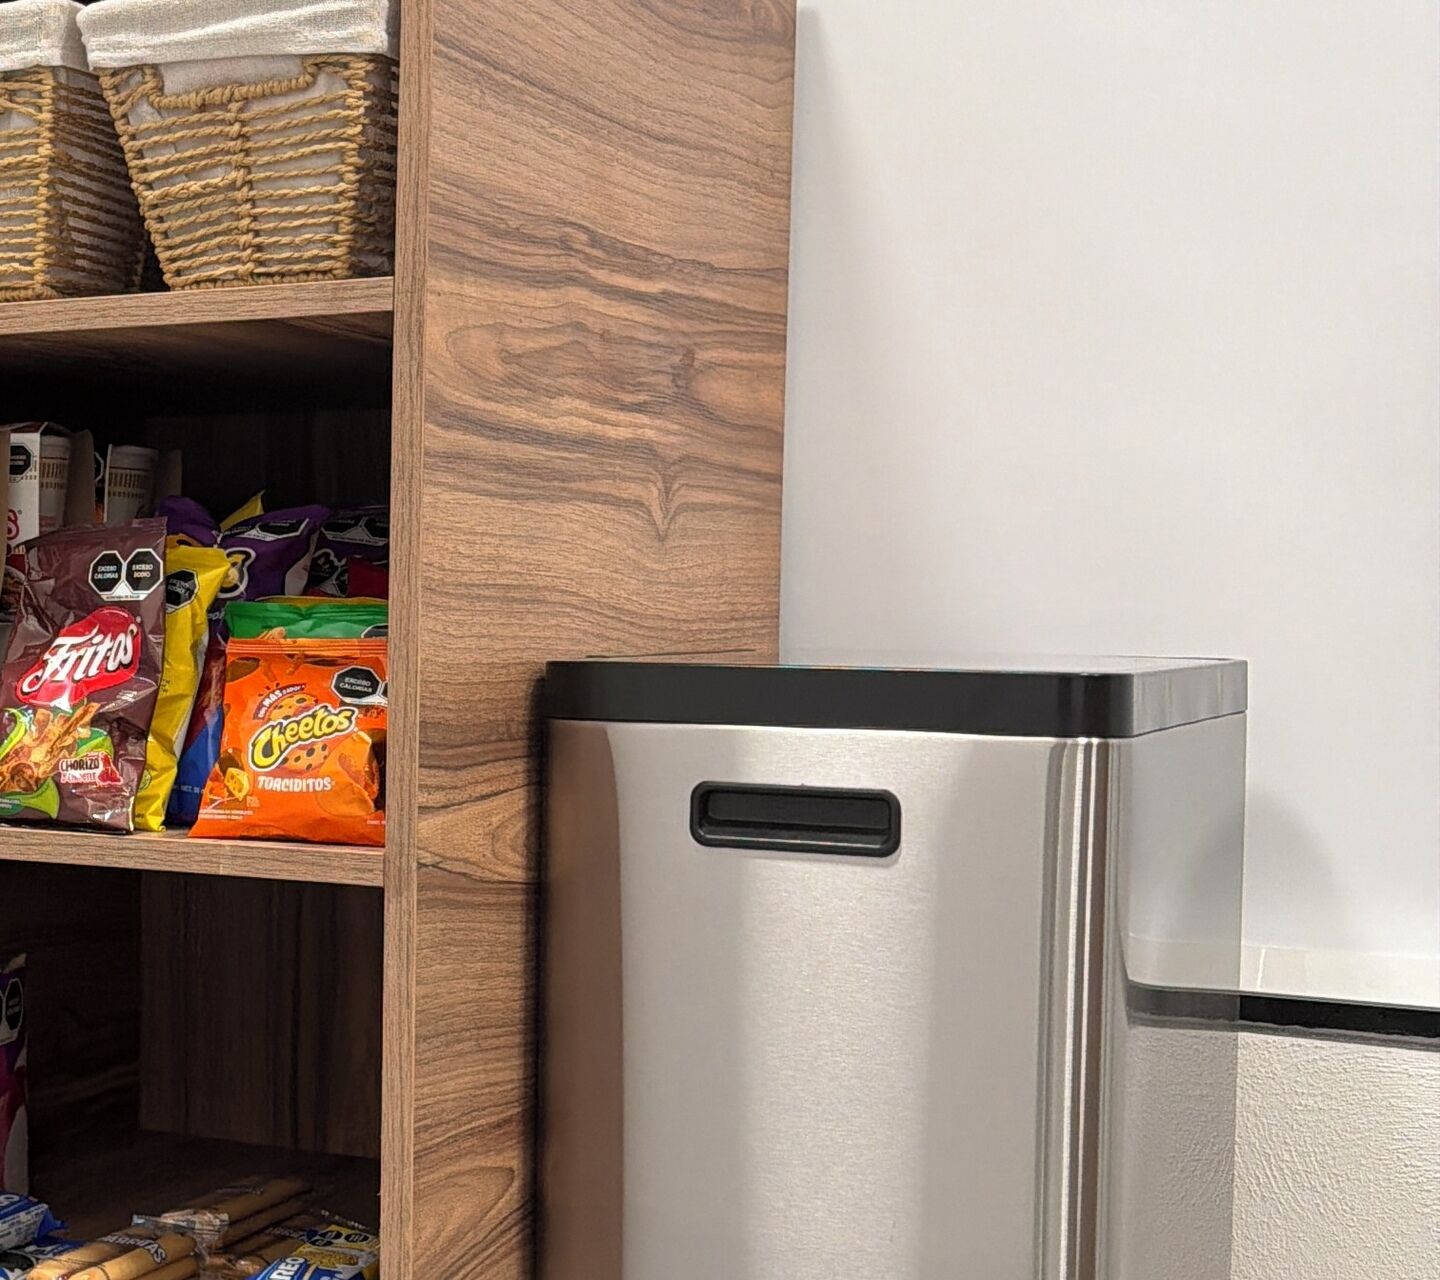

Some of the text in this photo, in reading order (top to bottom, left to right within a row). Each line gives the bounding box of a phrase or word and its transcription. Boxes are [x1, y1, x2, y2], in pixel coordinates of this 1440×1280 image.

[21, 623, 138, 696] Fritos
[251, 704, 356, 769] Cheetos
[61, 759, 100, 771] CHORIZO
[257, 776, 332, 792] TORCIDITOS
